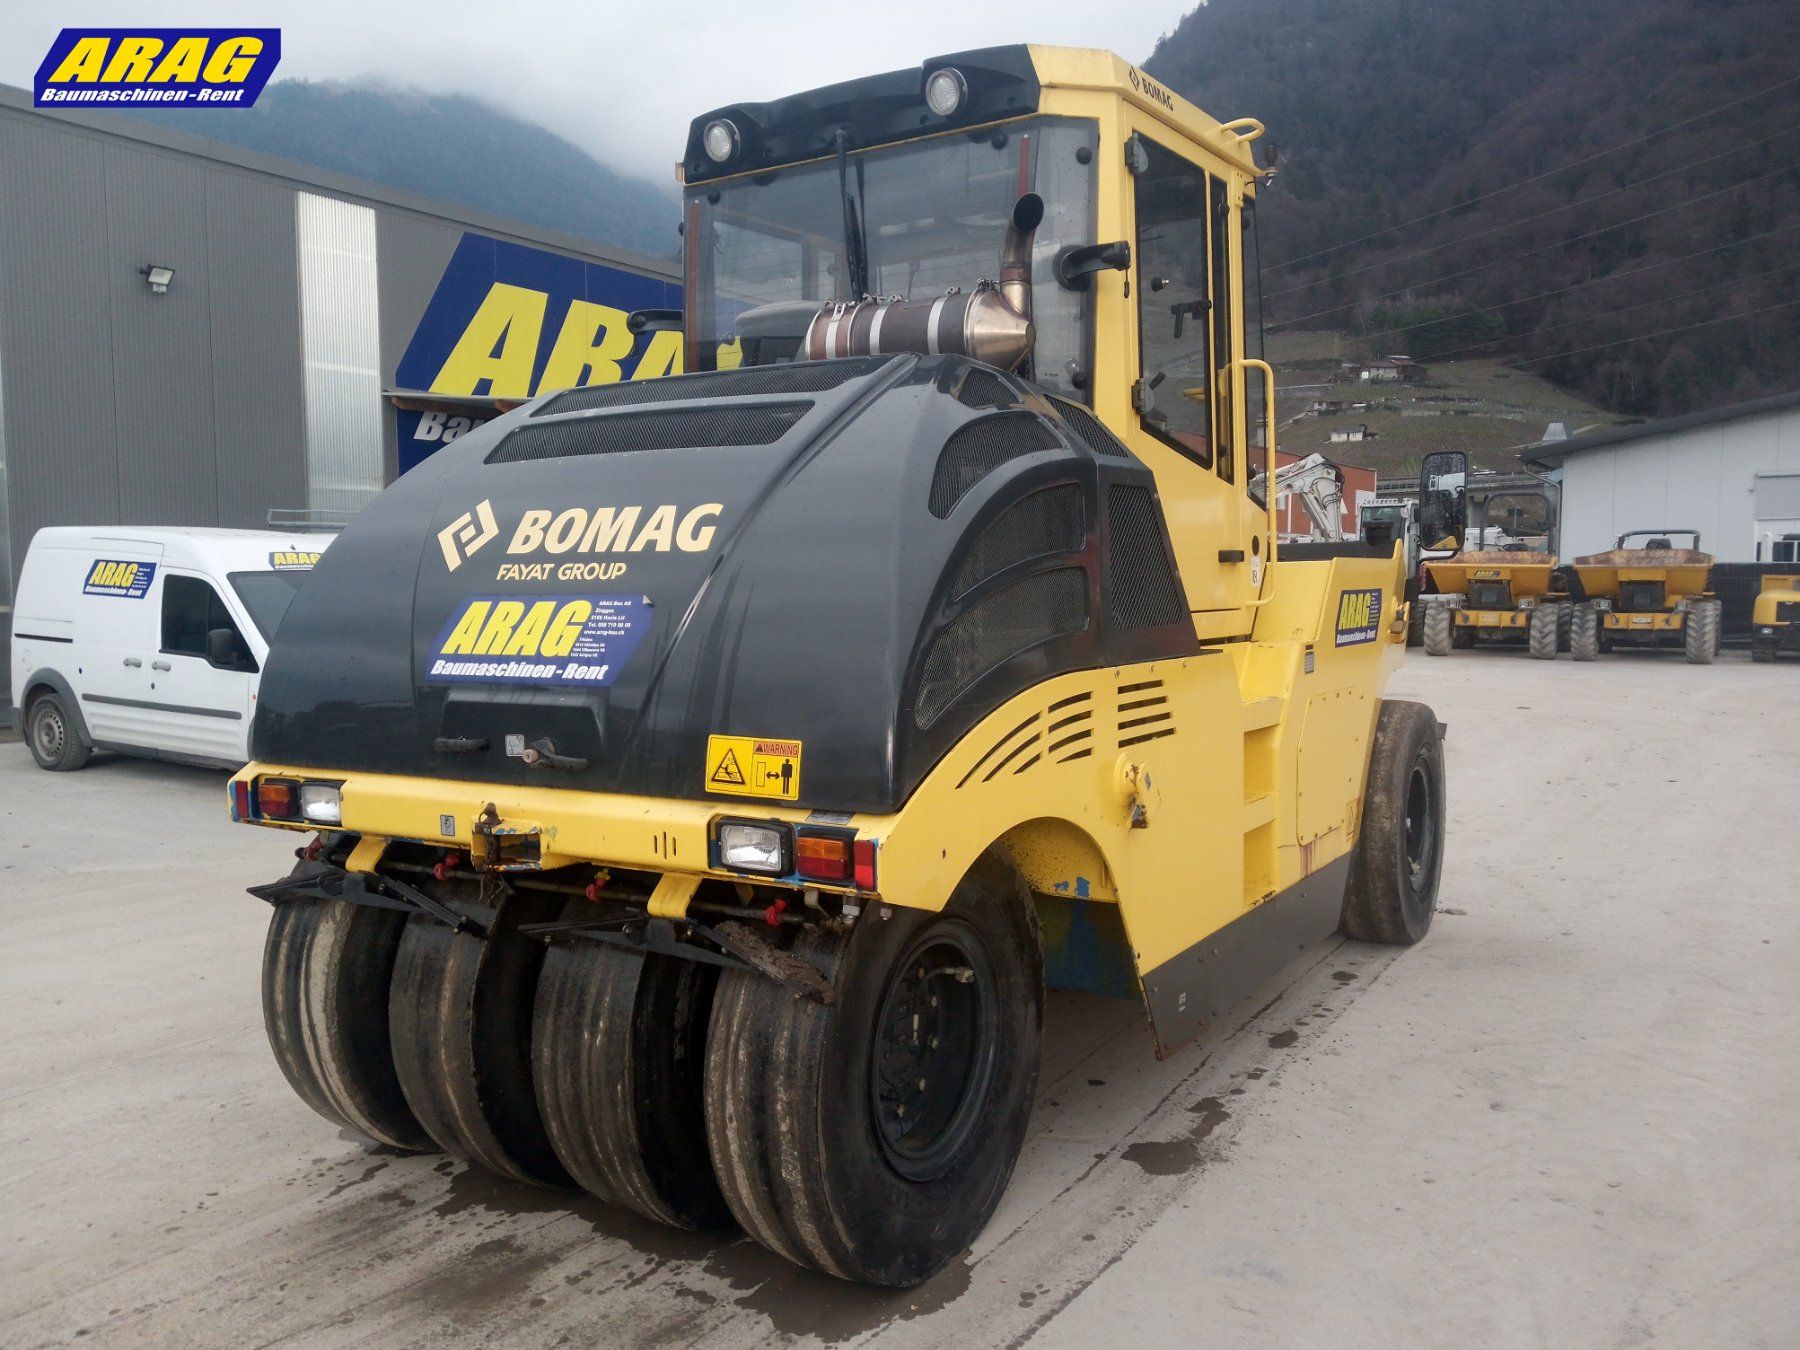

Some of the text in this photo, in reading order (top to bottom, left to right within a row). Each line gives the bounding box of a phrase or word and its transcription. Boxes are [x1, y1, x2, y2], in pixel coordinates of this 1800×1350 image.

[1142, 77, 1174, 111] BOMAG
[506, 503, 724, 555] BOMAG
[88, 561, 139, 587] ARAG
[496, 562, 627, 581] FAYAT GROUP
[1338, 592, 1372, 630] ARAG
[440, 600, 592, 657] ARAG
[430, 659, 609, 680] Baumaschinen-Rent
[763, 743, 798, 756] WARNING
